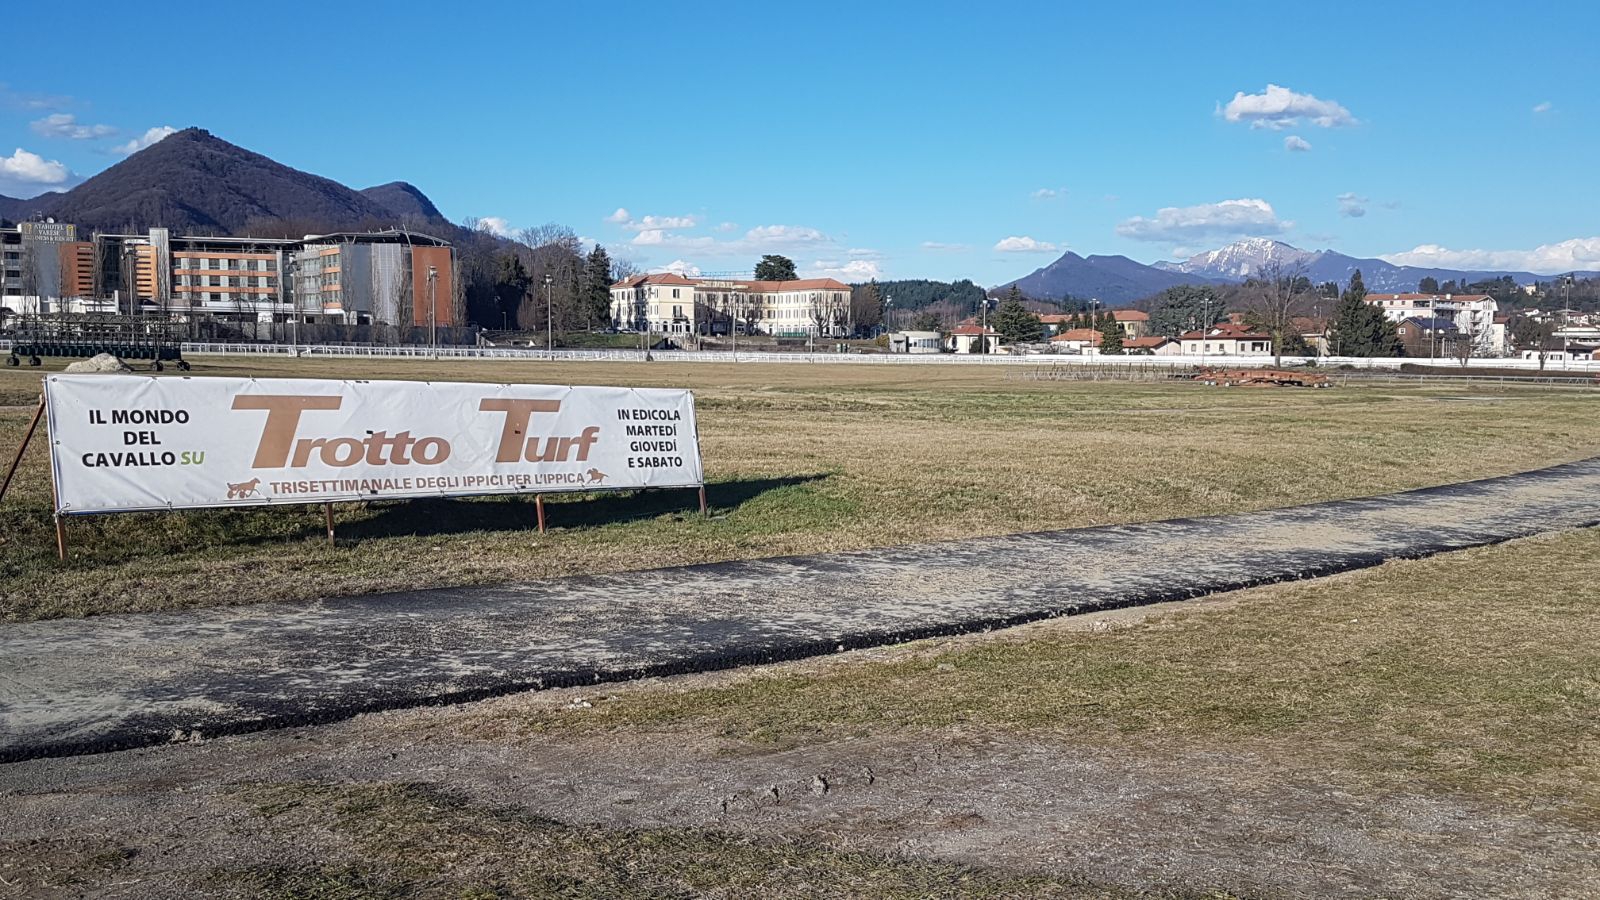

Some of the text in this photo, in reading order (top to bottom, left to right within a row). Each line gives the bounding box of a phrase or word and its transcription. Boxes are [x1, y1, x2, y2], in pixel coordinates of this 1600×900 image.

[89, 409, 190, 425] IL MONDO
[617, 409, 681, 421] IN EDICOLA
[231, 394, 451, 469] Trotto
[479, 398, 600, 463] Turf
[626, 423, 677, 436] MARTEDÍ
[123, 431, 162, 446] DEL
[630, 439, 677, 452] GIOVEDÍ
[81, 451, 206, 468] CAVALLO SU
[627, 456, 683, 468] E SABATO
[269, 472, 586, 494] TRISETTIMANALE DEGLI IPPICI PER L'IPPICA
